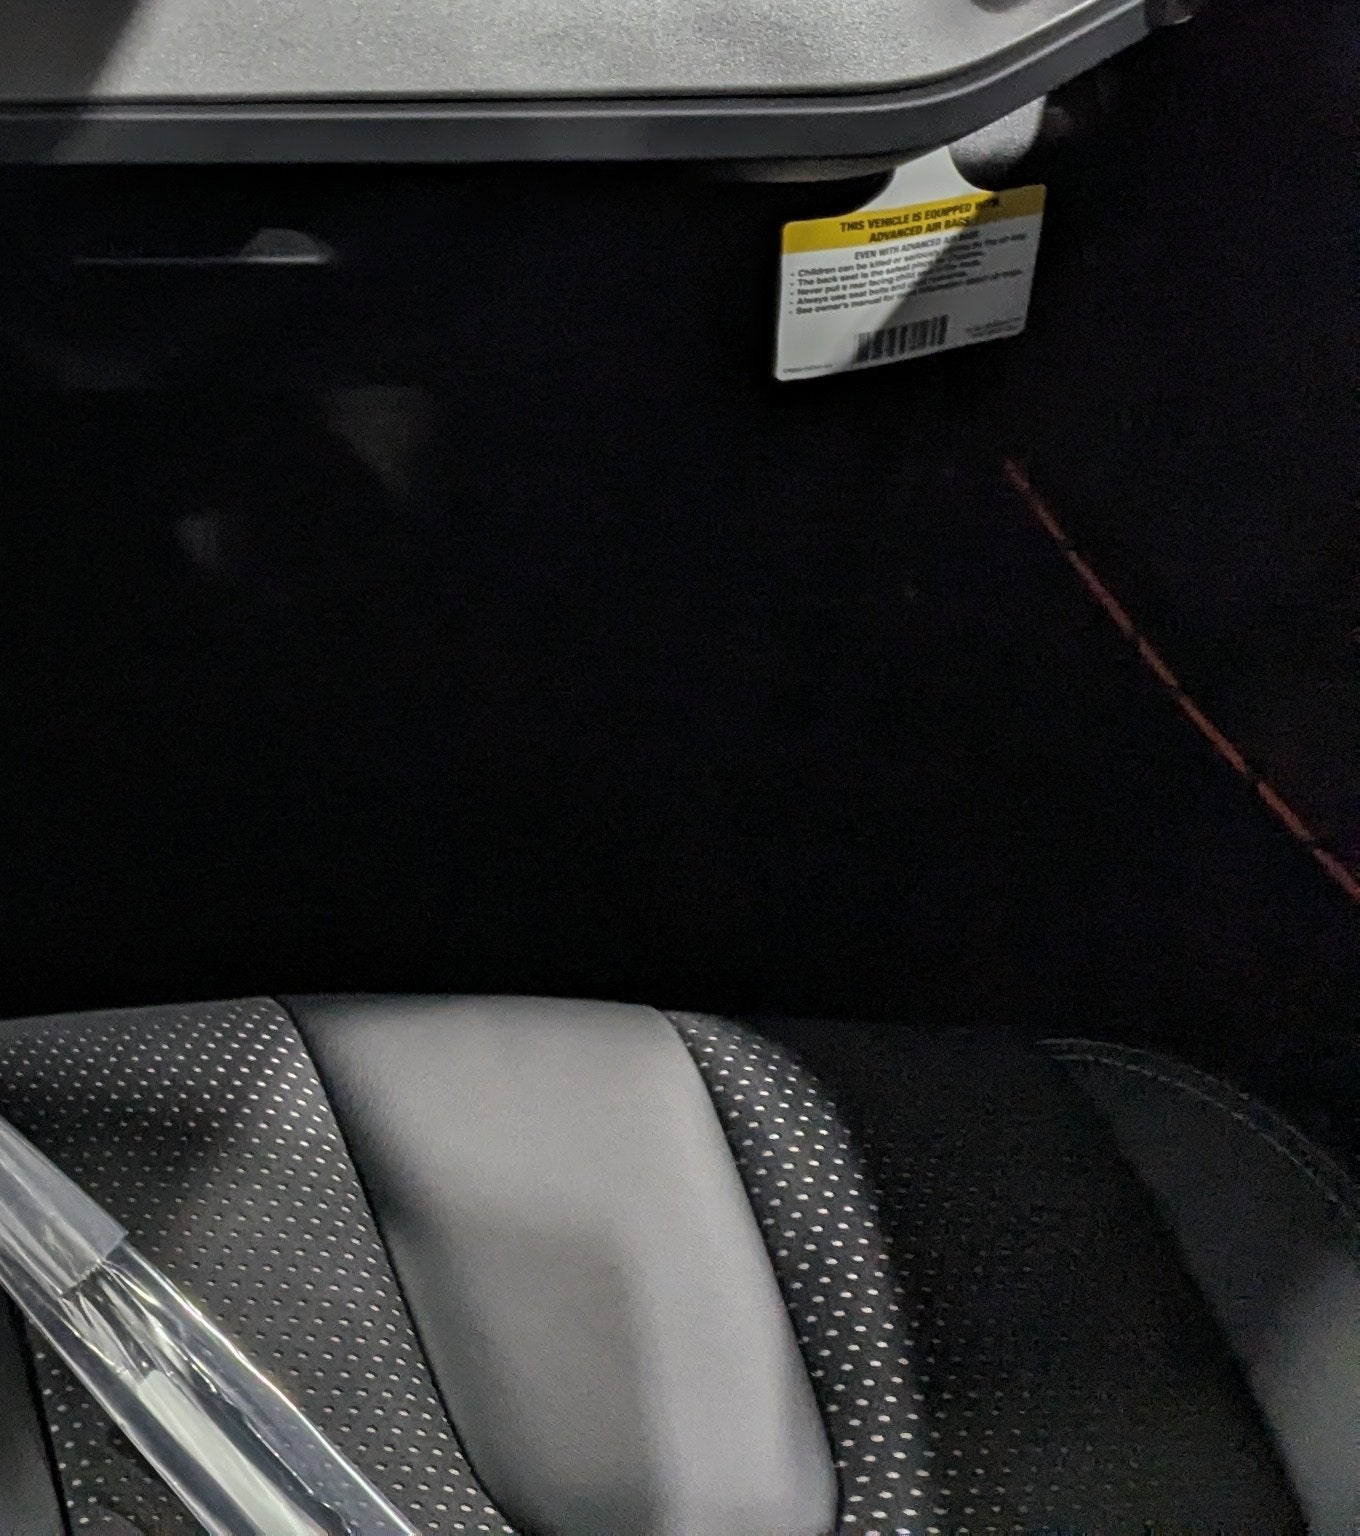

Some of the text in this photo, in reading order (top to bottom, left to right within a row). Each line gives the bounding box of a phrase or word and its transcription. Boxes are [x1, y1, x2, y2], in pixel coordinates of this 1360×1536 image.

[840, 222, 865, 232] THIS
[867, 214, 909, 229] VEHICLE
[911, 211, 922, 222] IS
[924, 203, 972, 219] EQUIPPED
[869, 225, 923, 243] ADVANCED
[926, 222, 942, 232] AIR
[854, 250, 877, 260] EVEN
[879, 245, 899, 256] WITH
[798, 278, 815, 287] The
